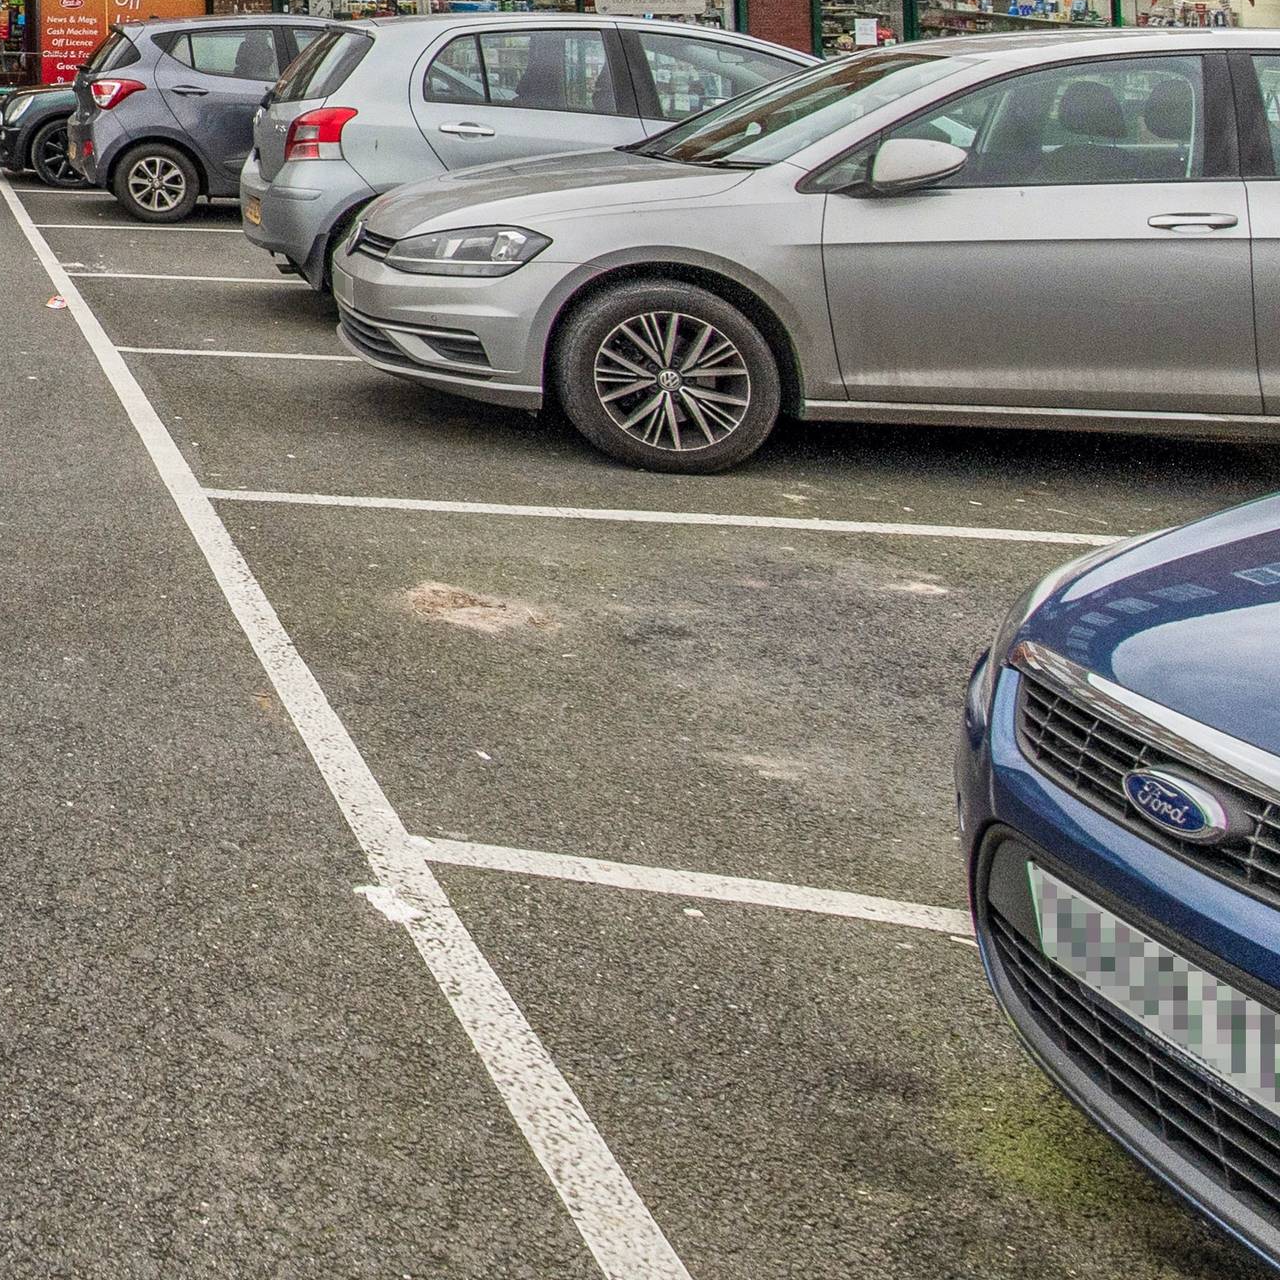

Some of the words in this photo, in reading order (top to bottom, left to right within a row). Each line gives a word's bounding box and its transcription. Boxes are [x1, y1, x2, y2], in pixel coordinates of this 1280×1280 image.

[47, 16, 67, 24] News
[69, 16, 76, 24] &
[77, 15, 97, 26] Mags
[47, 27, 64, 36] Cash
[66, 27, 98, 36] Machine
[52, 38, 65, 48] Off
[66, 38, 93, 47] Licence
[1138, 779, 1190, 824] Ford
